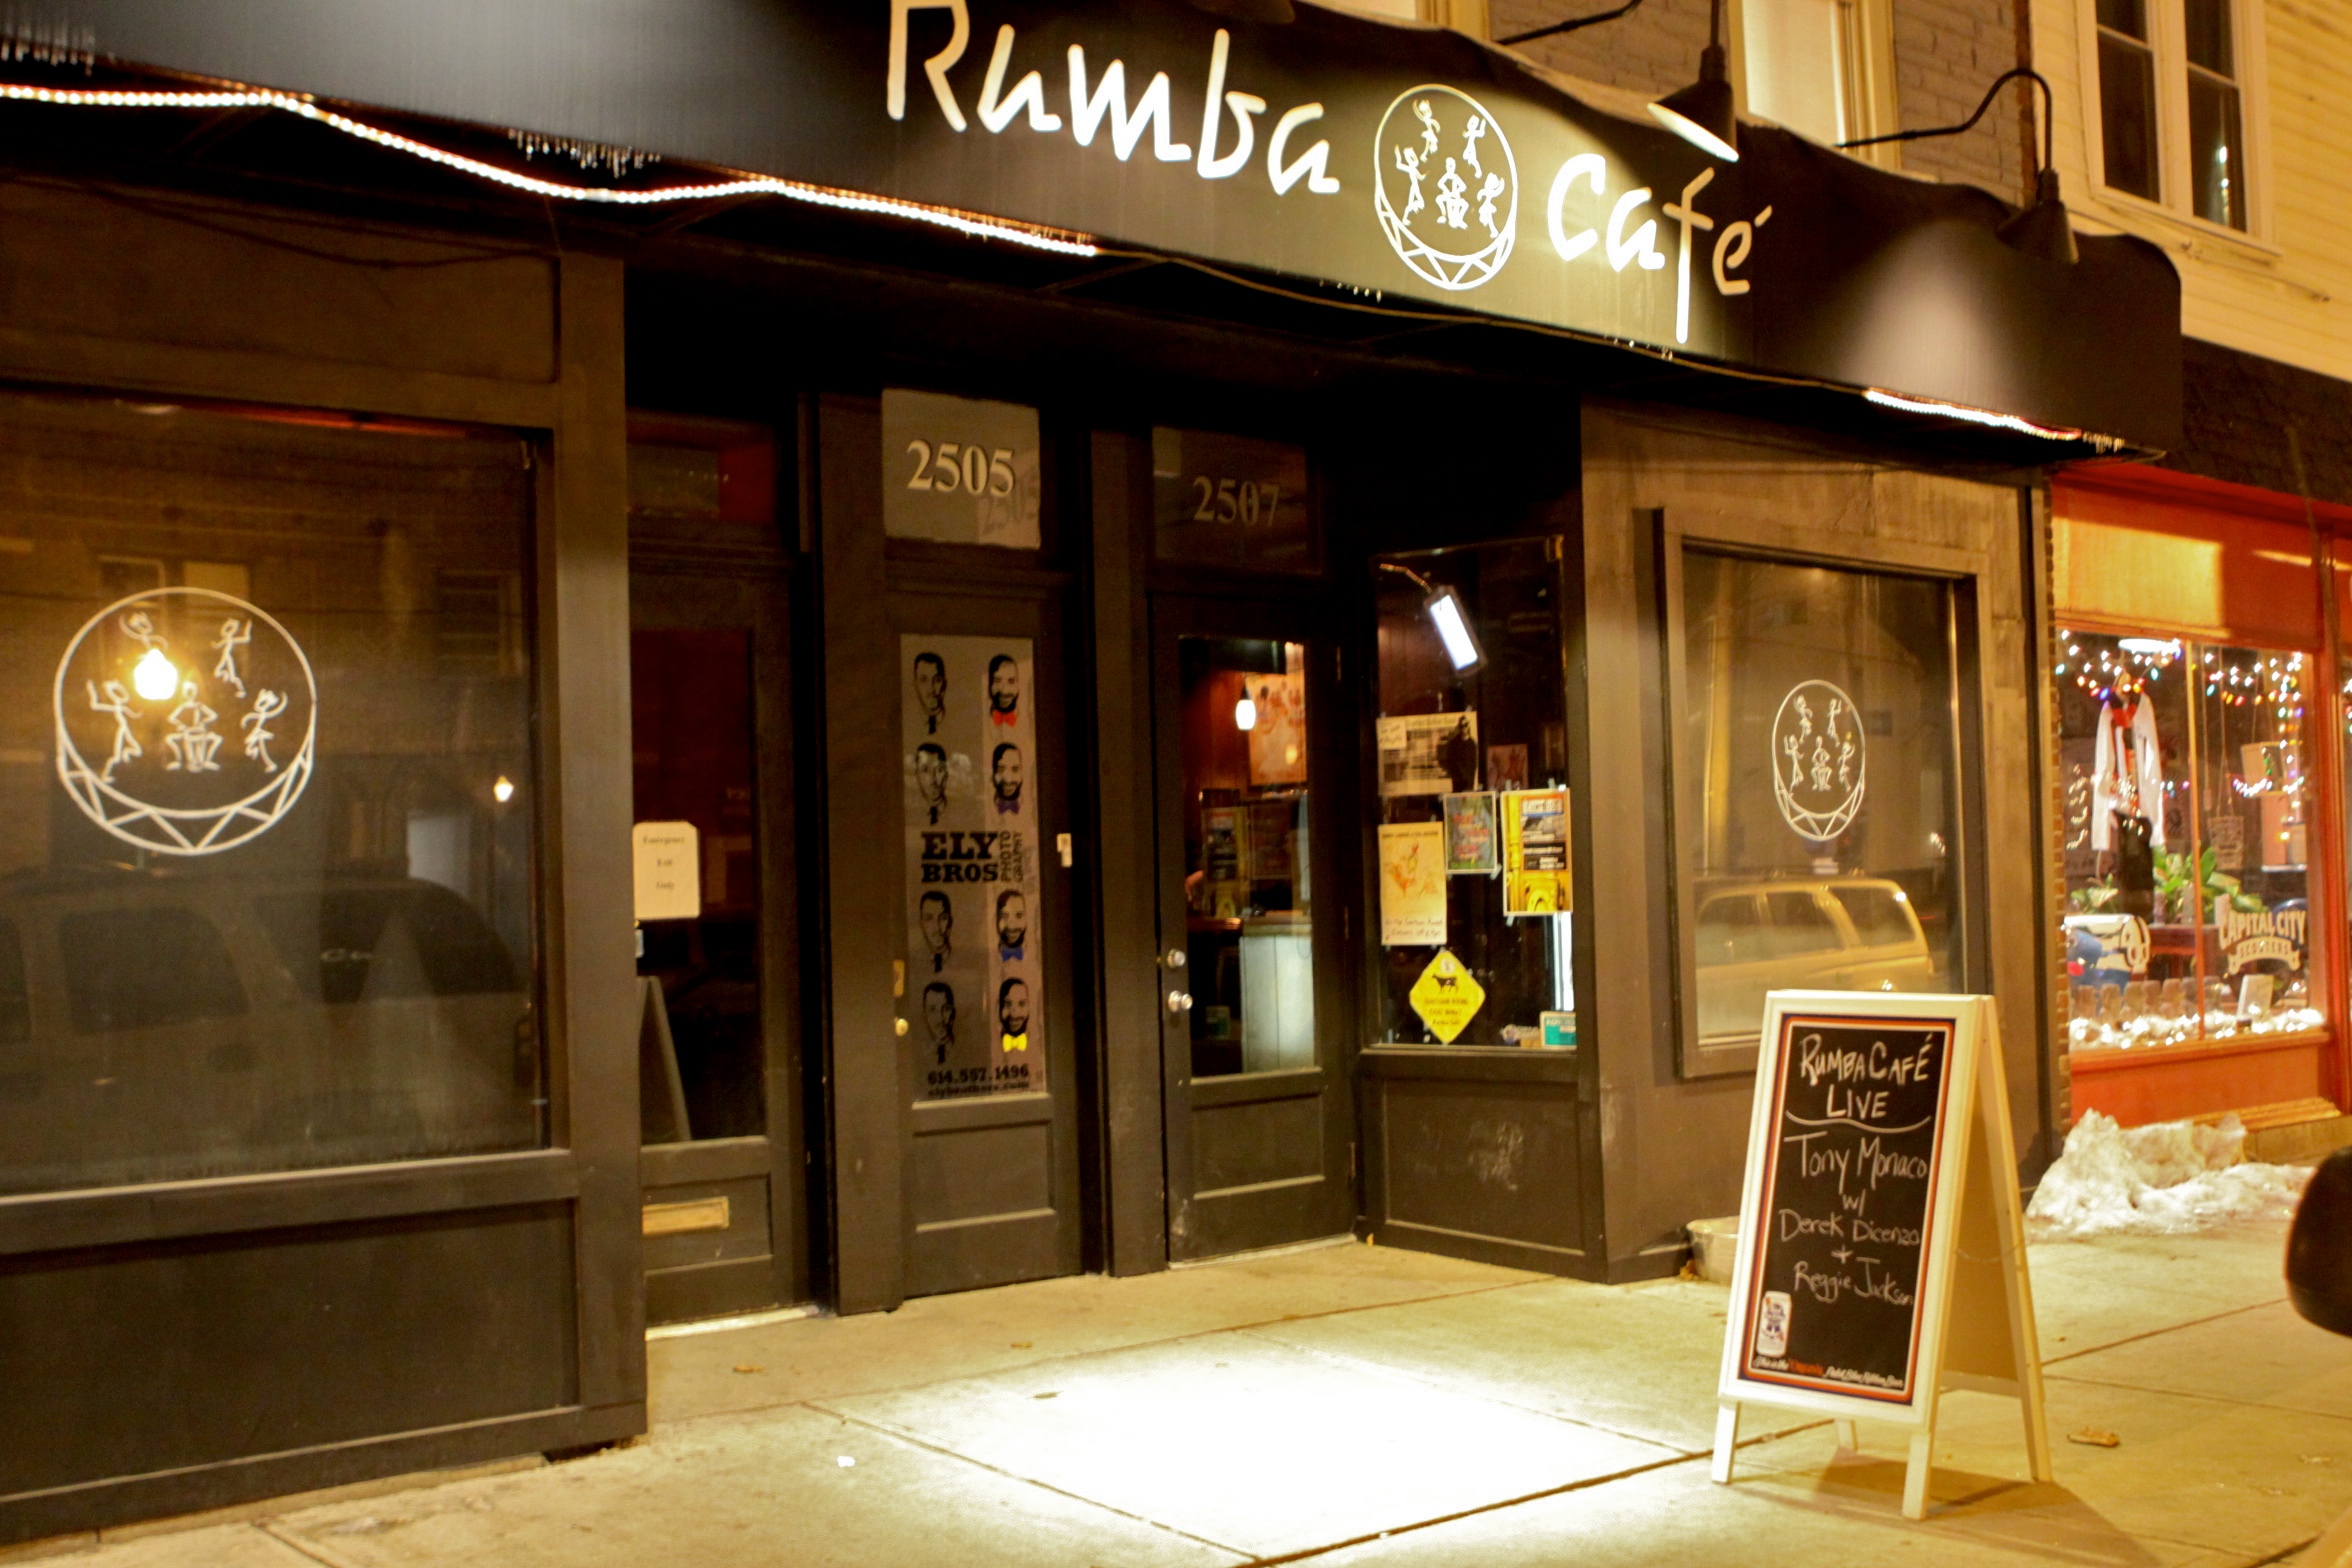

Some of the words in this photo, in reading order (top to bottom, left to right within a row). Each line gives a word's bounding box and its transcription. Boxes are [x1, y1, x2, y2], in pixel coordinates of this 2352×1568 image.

[887, 0, 1340, 197] Rumba
[1547, 153, 1773, 344] Café
[906, 438, 1015, 498] 2505
[1192, 475, 1280, 528] 2507
[921, 831, 998, 860] ELY
[999, 829, 1012, 883] PHOTO
[921, 862, 999, 883] BROS
[2218, 909, 2276, 951] CAPITAL
[2275, 909, 2307, 946] CITY
[1868, 1032, 1933, 1086] CAFÉ
[1826, 1083, 1890, 1120] LIVE
[1783, 1130, 1850, 1196] Tony
[1856, 1135, 1928, 1191] Monaco
[1778, 1208, 1845, 1243] Derek
[1793, 1260, 1852, 1304] Reggie
